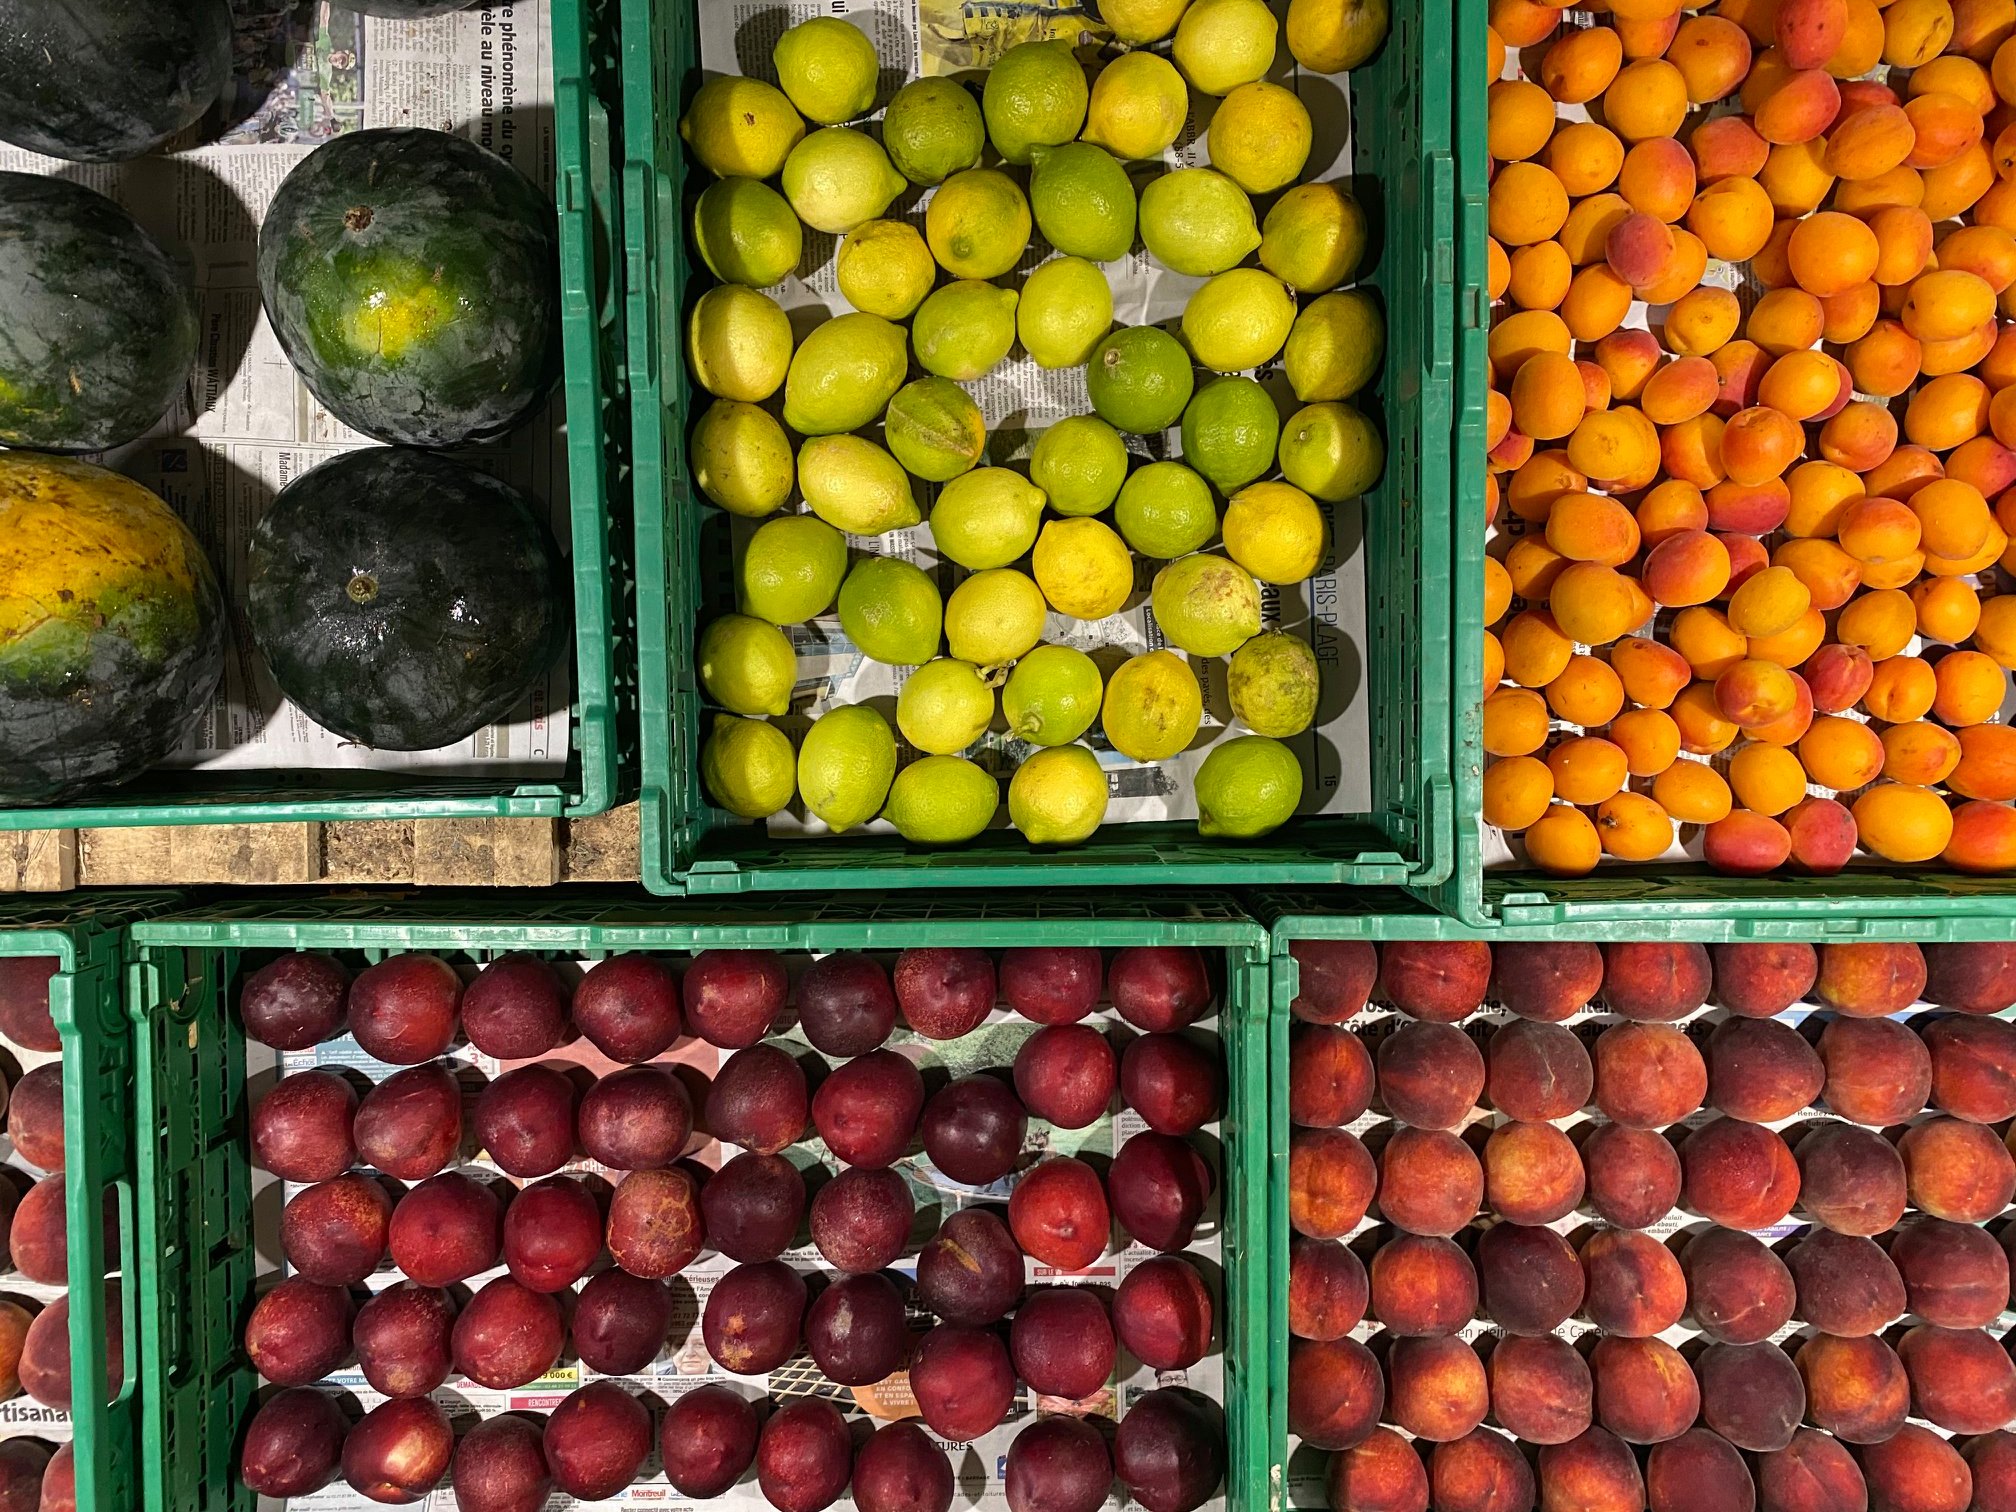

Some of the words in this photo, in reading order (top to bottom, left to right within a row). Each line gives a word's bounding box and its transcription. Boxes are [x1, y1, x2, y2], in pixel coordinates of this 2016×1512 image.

[481, 41, 493, 60] au
[498, 23, 518, 115] phénomène
[481, 65, 498, 117] niveau
[481, 123, 493, 151] mo
[502, 120, 517, 139] du
[499, 144, 513, 163] cy
[204, 369, 220, 413] WATTIAUX
[1145, 608, 1157, 647] Localisation
[1200, 658, 1213, 675] des
[1199, 676, 1214, 708] pavés,
[534, 705, 546, 730] avis
[1202, 708, 1215, 726] des
[1324, 775, 1337, 787] 15
[632, 1488, 666, 1497] Montreuil
